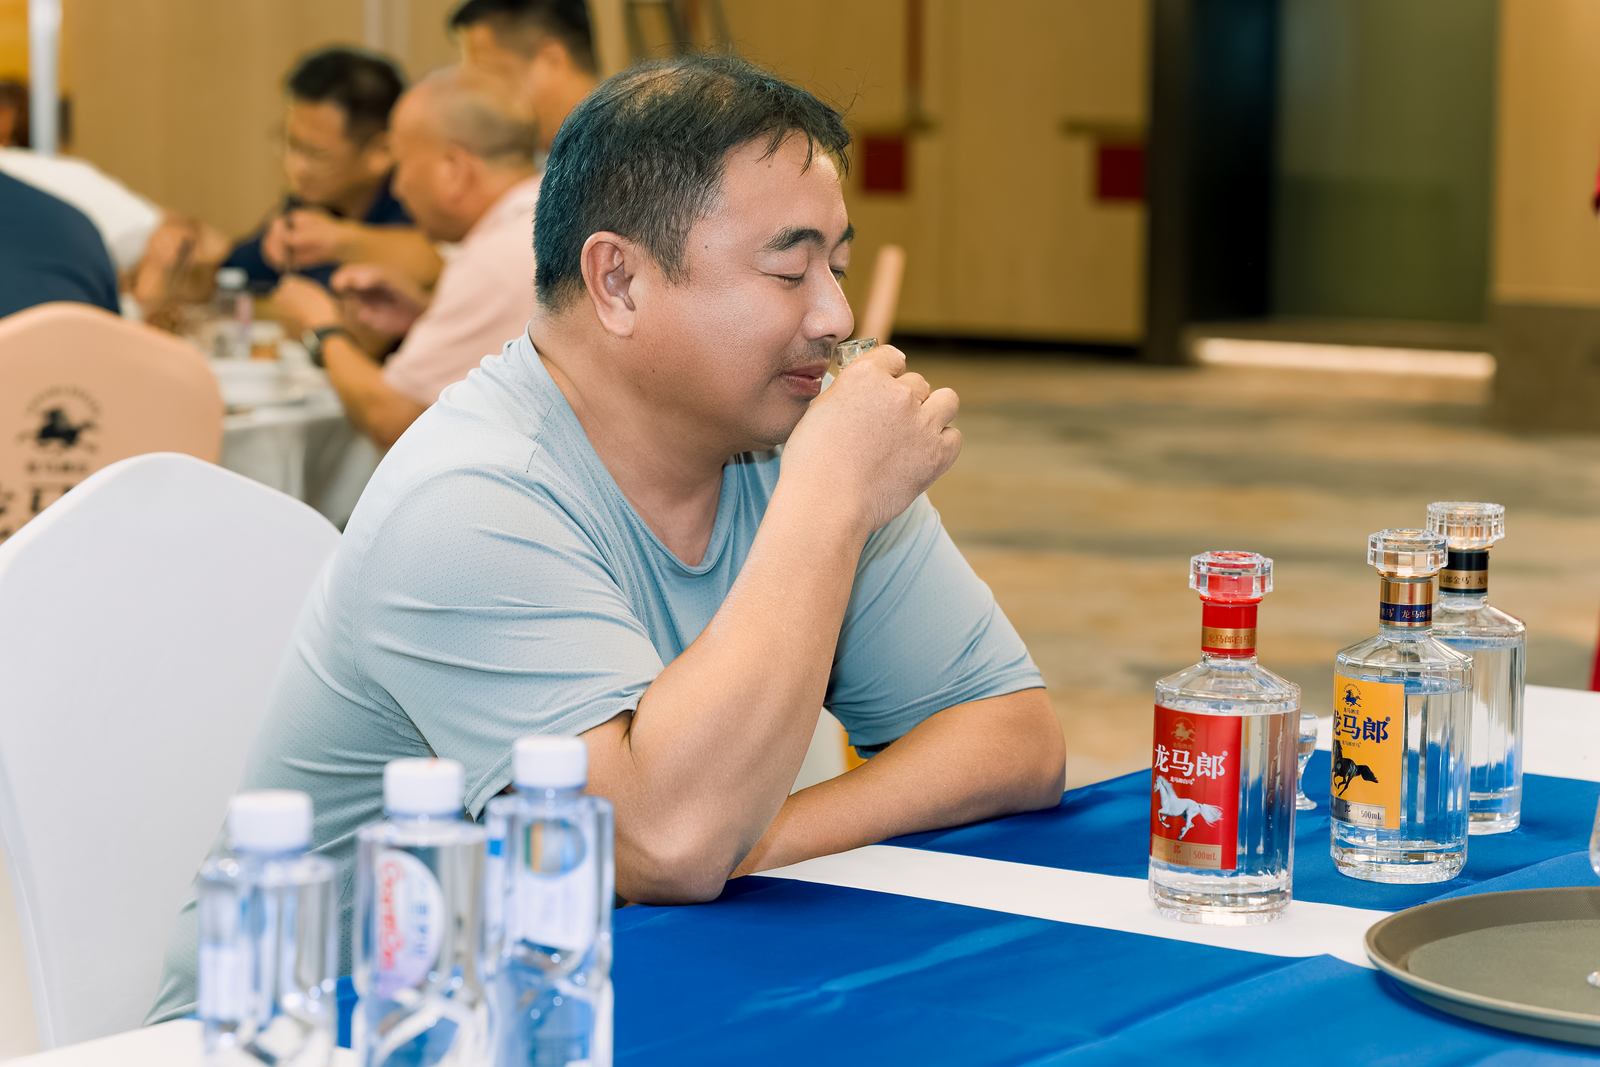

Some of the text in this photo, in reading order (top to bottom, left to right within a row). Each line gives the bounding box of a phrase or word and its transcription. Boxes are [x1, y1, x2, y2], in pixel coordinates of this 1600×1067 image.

[1154, 743, 1226, 780] 龙马郎
[1360, 809, 1383, 821] 500mL
[1192, 850, 1218, 861] 500mL
